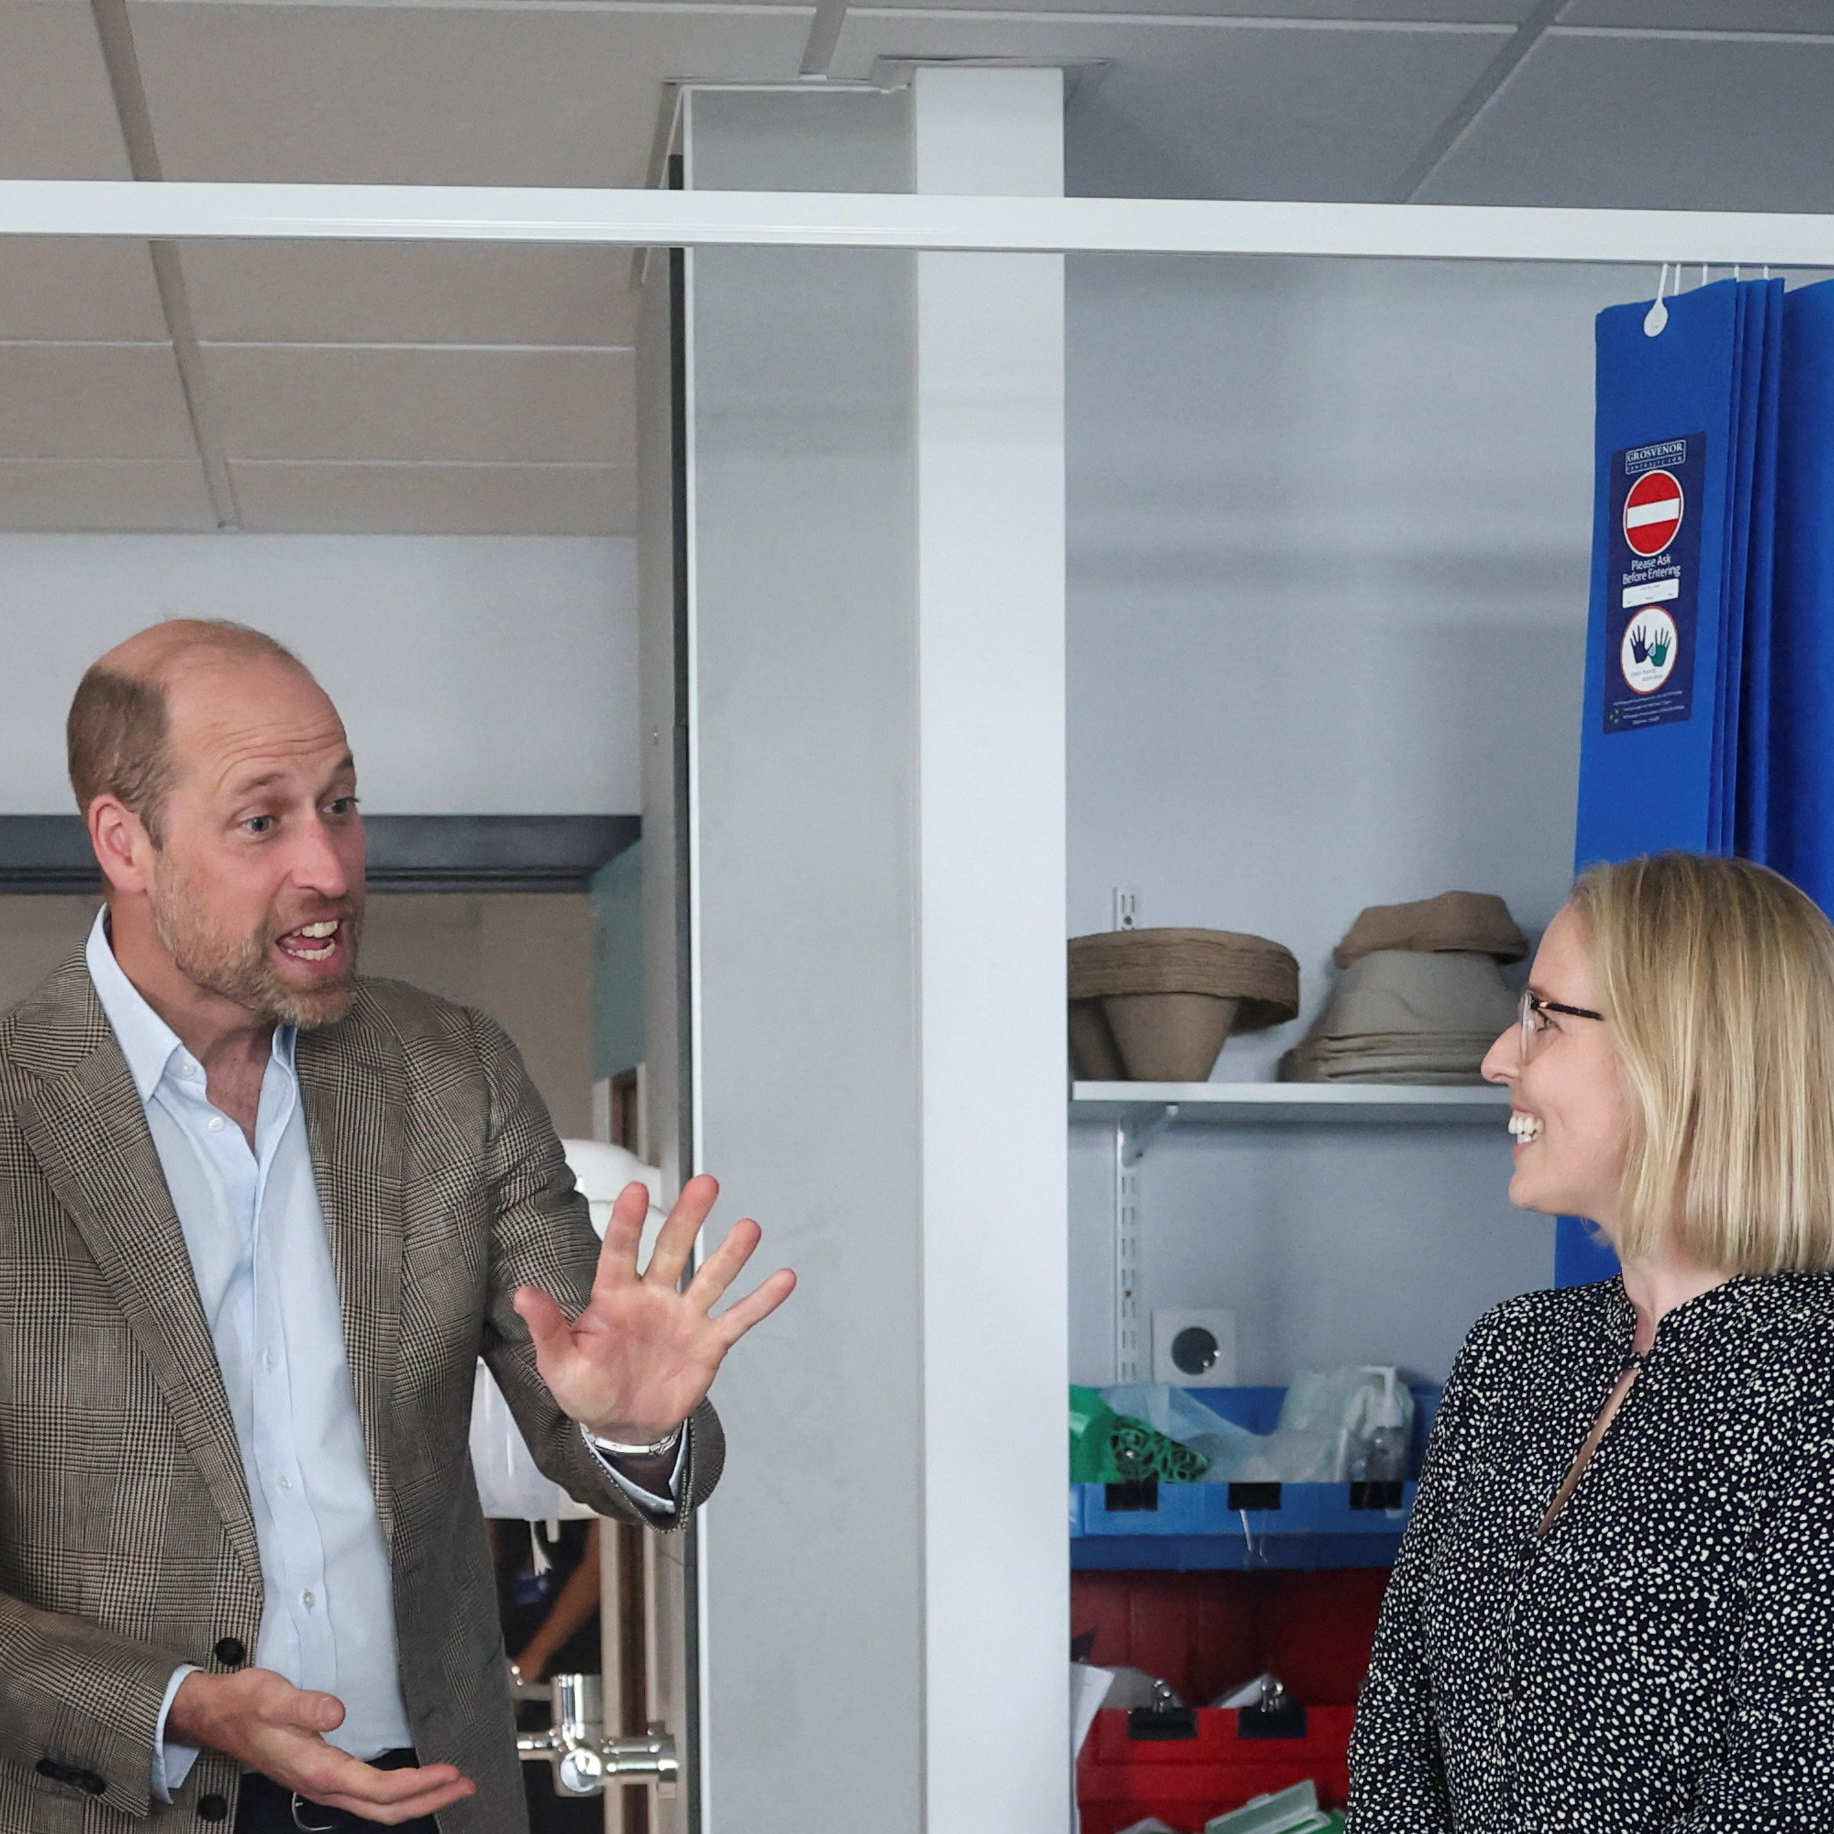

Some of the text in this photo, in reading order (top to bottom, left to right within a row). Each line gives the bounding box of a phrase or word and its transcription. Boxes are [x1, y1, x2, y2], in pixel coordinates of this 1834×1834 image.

[1628, 443, 1683, 462] GROSVENOR
[1631, 554, 1671, 571] Please Ask
[1622, 565, 1681, 585] Before Entering
